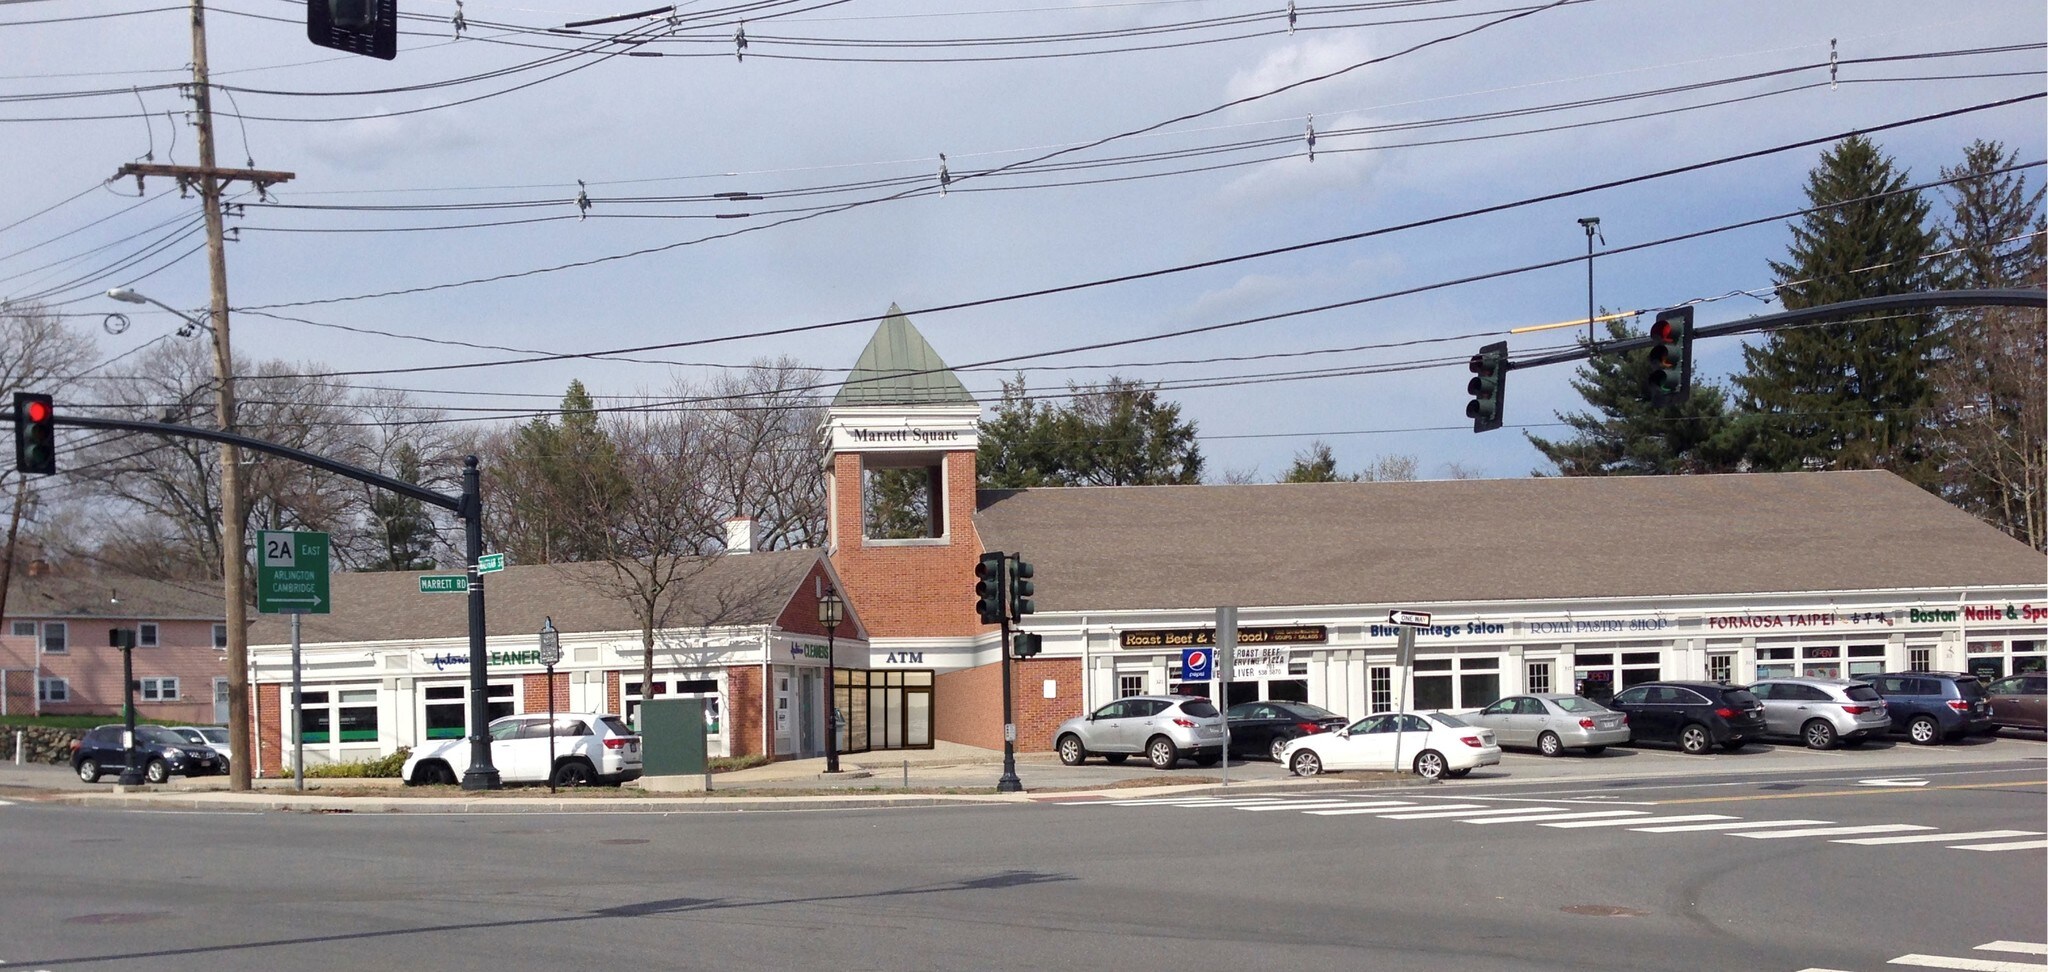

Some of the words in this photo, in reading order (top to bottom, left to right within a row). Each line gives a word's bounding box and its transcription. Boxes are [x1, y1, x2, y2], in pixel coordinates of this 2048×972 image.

[854, 428, 907, 442] Marrett
[912, 427, 958, 444] Square
[268, 540, 292, 559] 2A
[273, 570, 315, 580] ARLINGTON
[272, 582, 316, 593] CAMBRIDGE
[421, 579, 452, 589] MARRETT
[456, 579, 467, 589] RD
[1414, 615, 1427, 623] WAY
[1709, 615, 1783, 629] FORMOSA
[1787, 612, 1835, 626] TAIPEI
[1850, 611, 1888, 625] 古早味
[1910, 608, 1957, 623] Boston
[1964, 605, 2003, 621] Nails
[2006, 604, 2018, 620] &
[1370, 624, 1400, 637] Blue
[1416, 622, 1461, 638] intage
[1466, 622, 1504, 635] Salon
[1531, 621, 1572, 634] ROYAL
[1576, 620, 1625, 633] PASTRY
[1629, 618, 1668, 631] SHOP
[1126, 633, 1161, 646] Roast
[1165, 632, 1194, 645] Beef
[1196, 633, 1207, 643] &
[886, 651, 923, 664] ATM
[1236, 649, 1259, 658] ROAST
[1262, 648, 1280, 657] BEEF
[1233, 658, 1259, 666] ERVING
[1262, 656, 1284, 664] PIZZA
